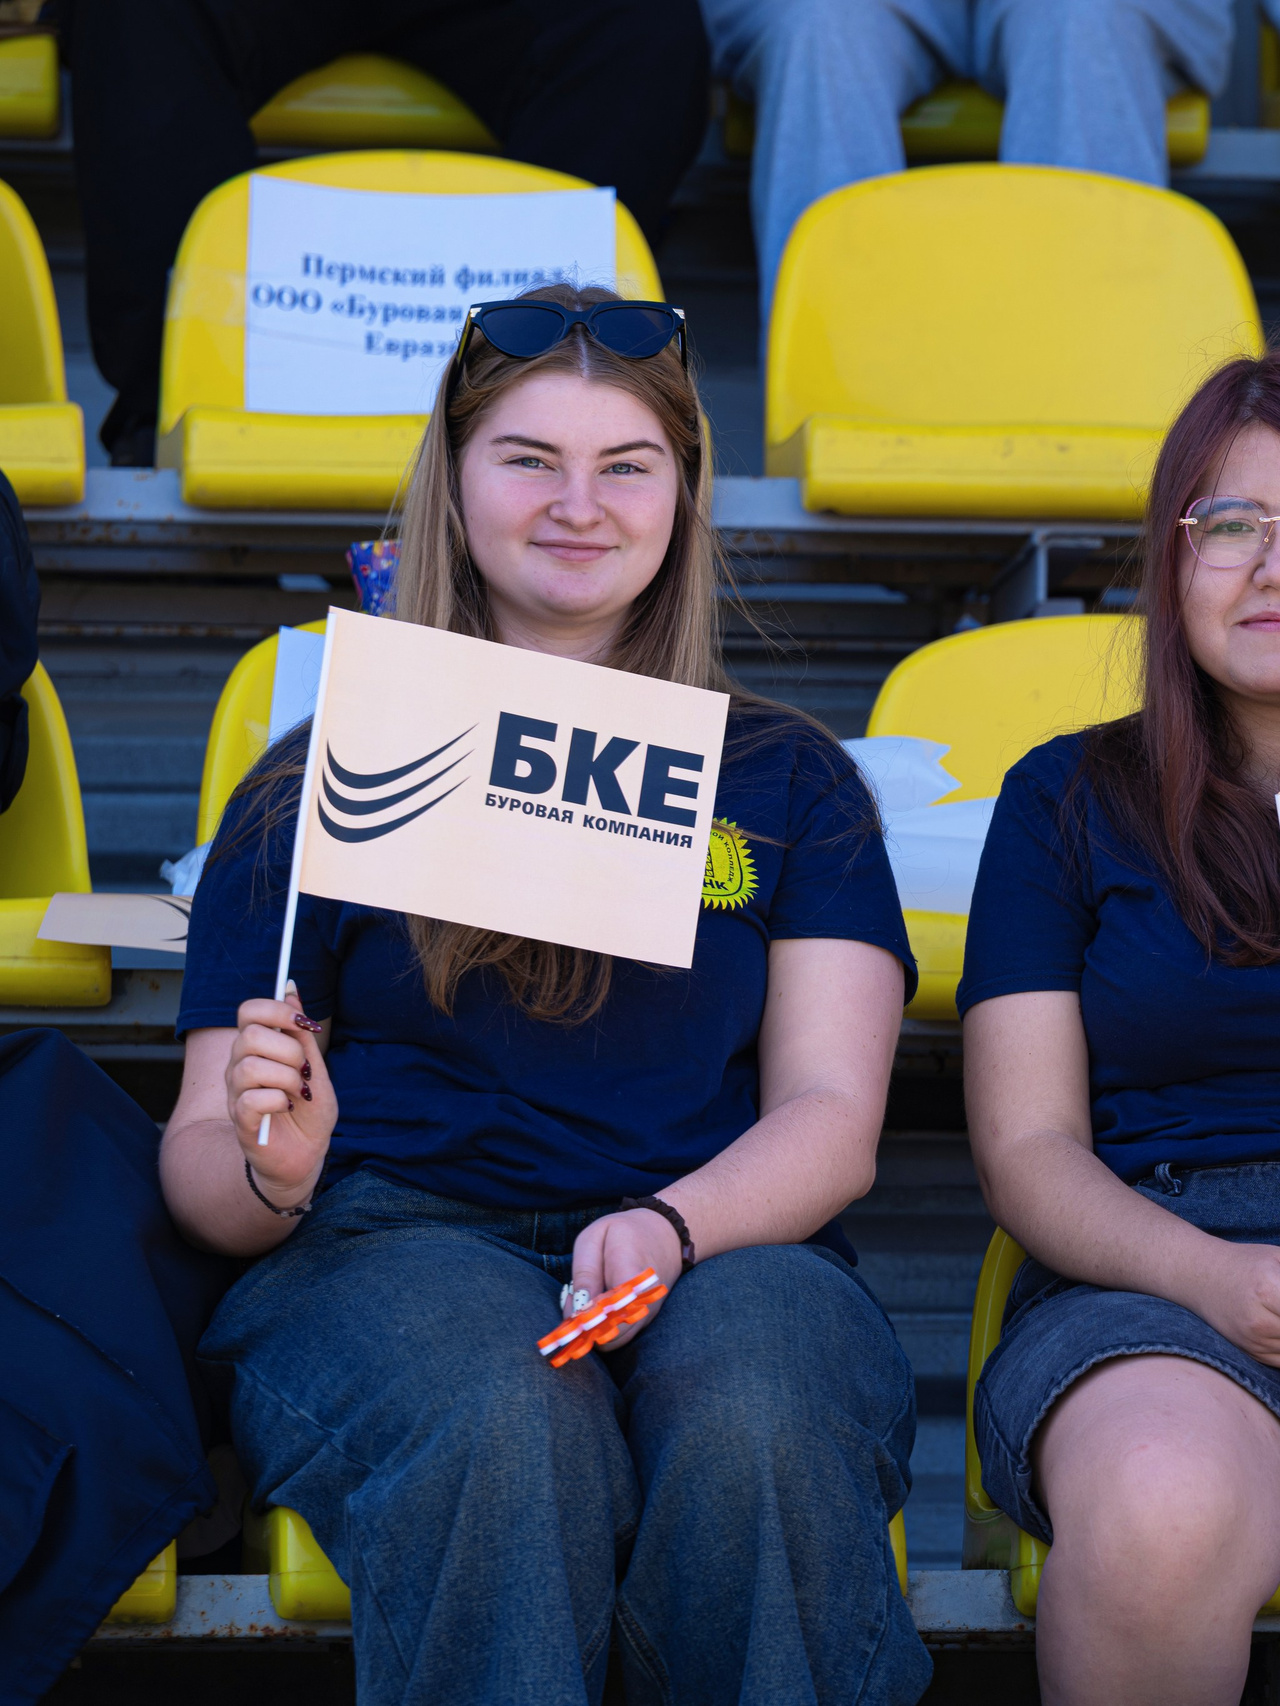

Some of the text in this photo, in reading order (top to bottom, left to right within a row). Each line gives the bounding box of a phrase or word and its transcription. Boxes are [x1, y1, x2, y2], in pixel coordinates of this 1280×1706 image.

[303, 253, 446, 288] Пермский
[252, 282, 463, 326] ООО «Буровая
[489, 711, 705, 828] БКЕ
[485, 793, 693, 849] БУРОВАЯ КОМПАНИЯ
